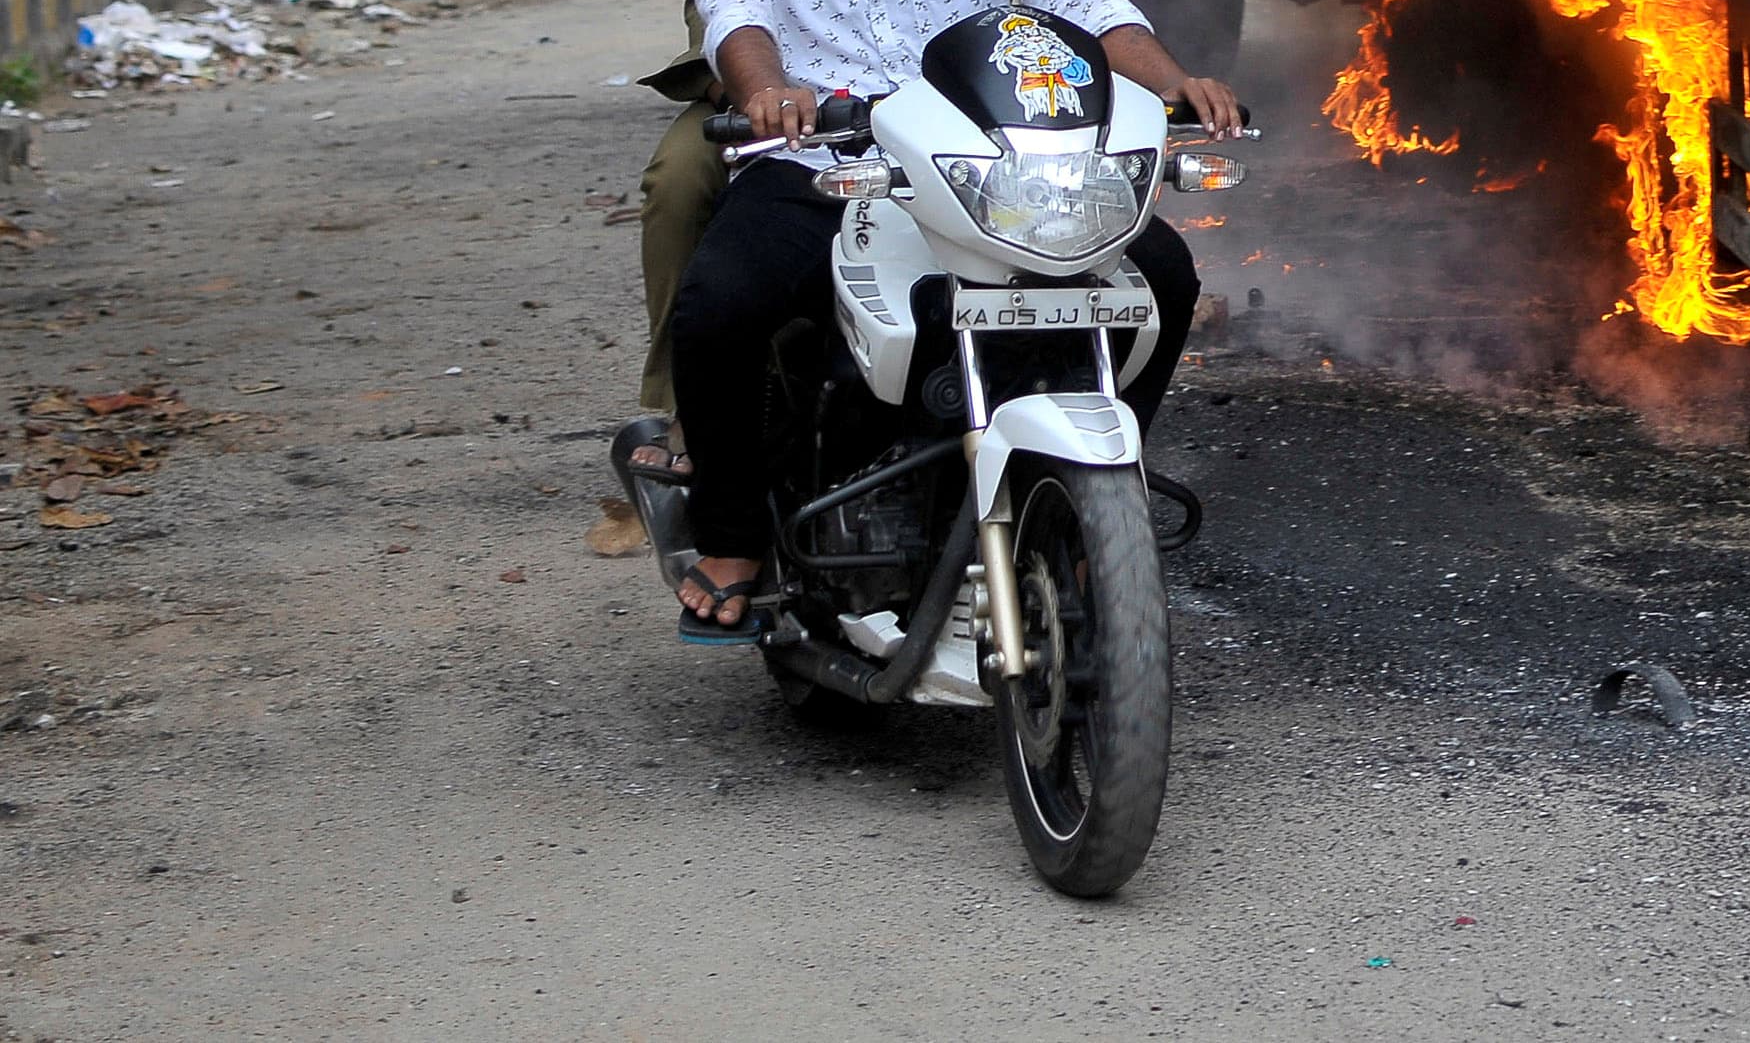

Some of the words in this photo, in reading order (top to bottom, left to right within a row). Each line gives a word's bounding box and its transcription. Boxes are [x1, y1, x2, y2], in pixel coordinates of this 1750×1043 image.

[853, 200, 878, 253] ache
[956, 308, 988, 325] KA
[998, 308, 1037, 325] 05
[1045, 308, 1079, 324] JJ
[1090, 306, 1149, 323] 1049
